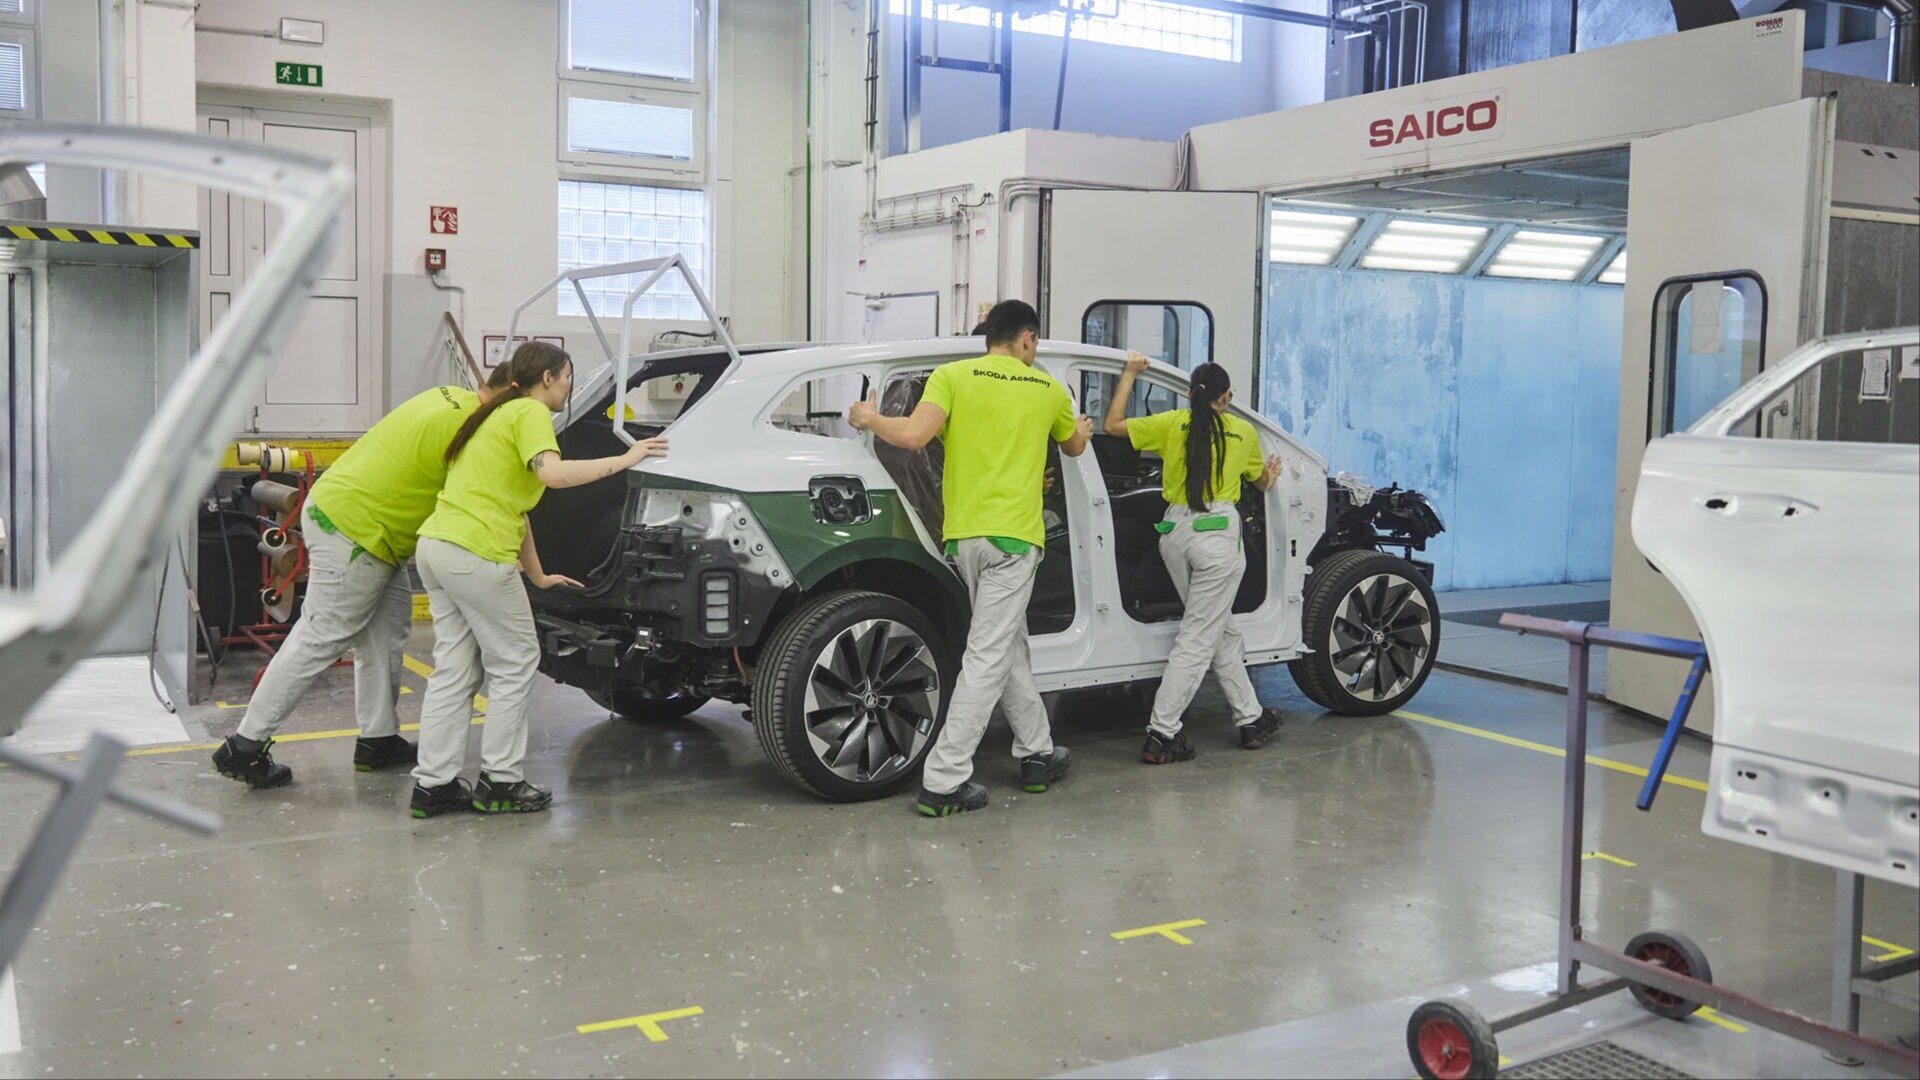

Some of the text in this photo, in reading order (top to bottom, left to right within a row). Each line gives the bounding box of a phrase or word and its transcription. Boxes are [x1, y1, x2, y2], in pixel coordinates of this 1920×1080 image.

[1755, 17, 1783, 27] ROMAN
[1369, 100, 1497, 148] SAICO
[973, 368, 1051, 388] ŠKODA Academy
